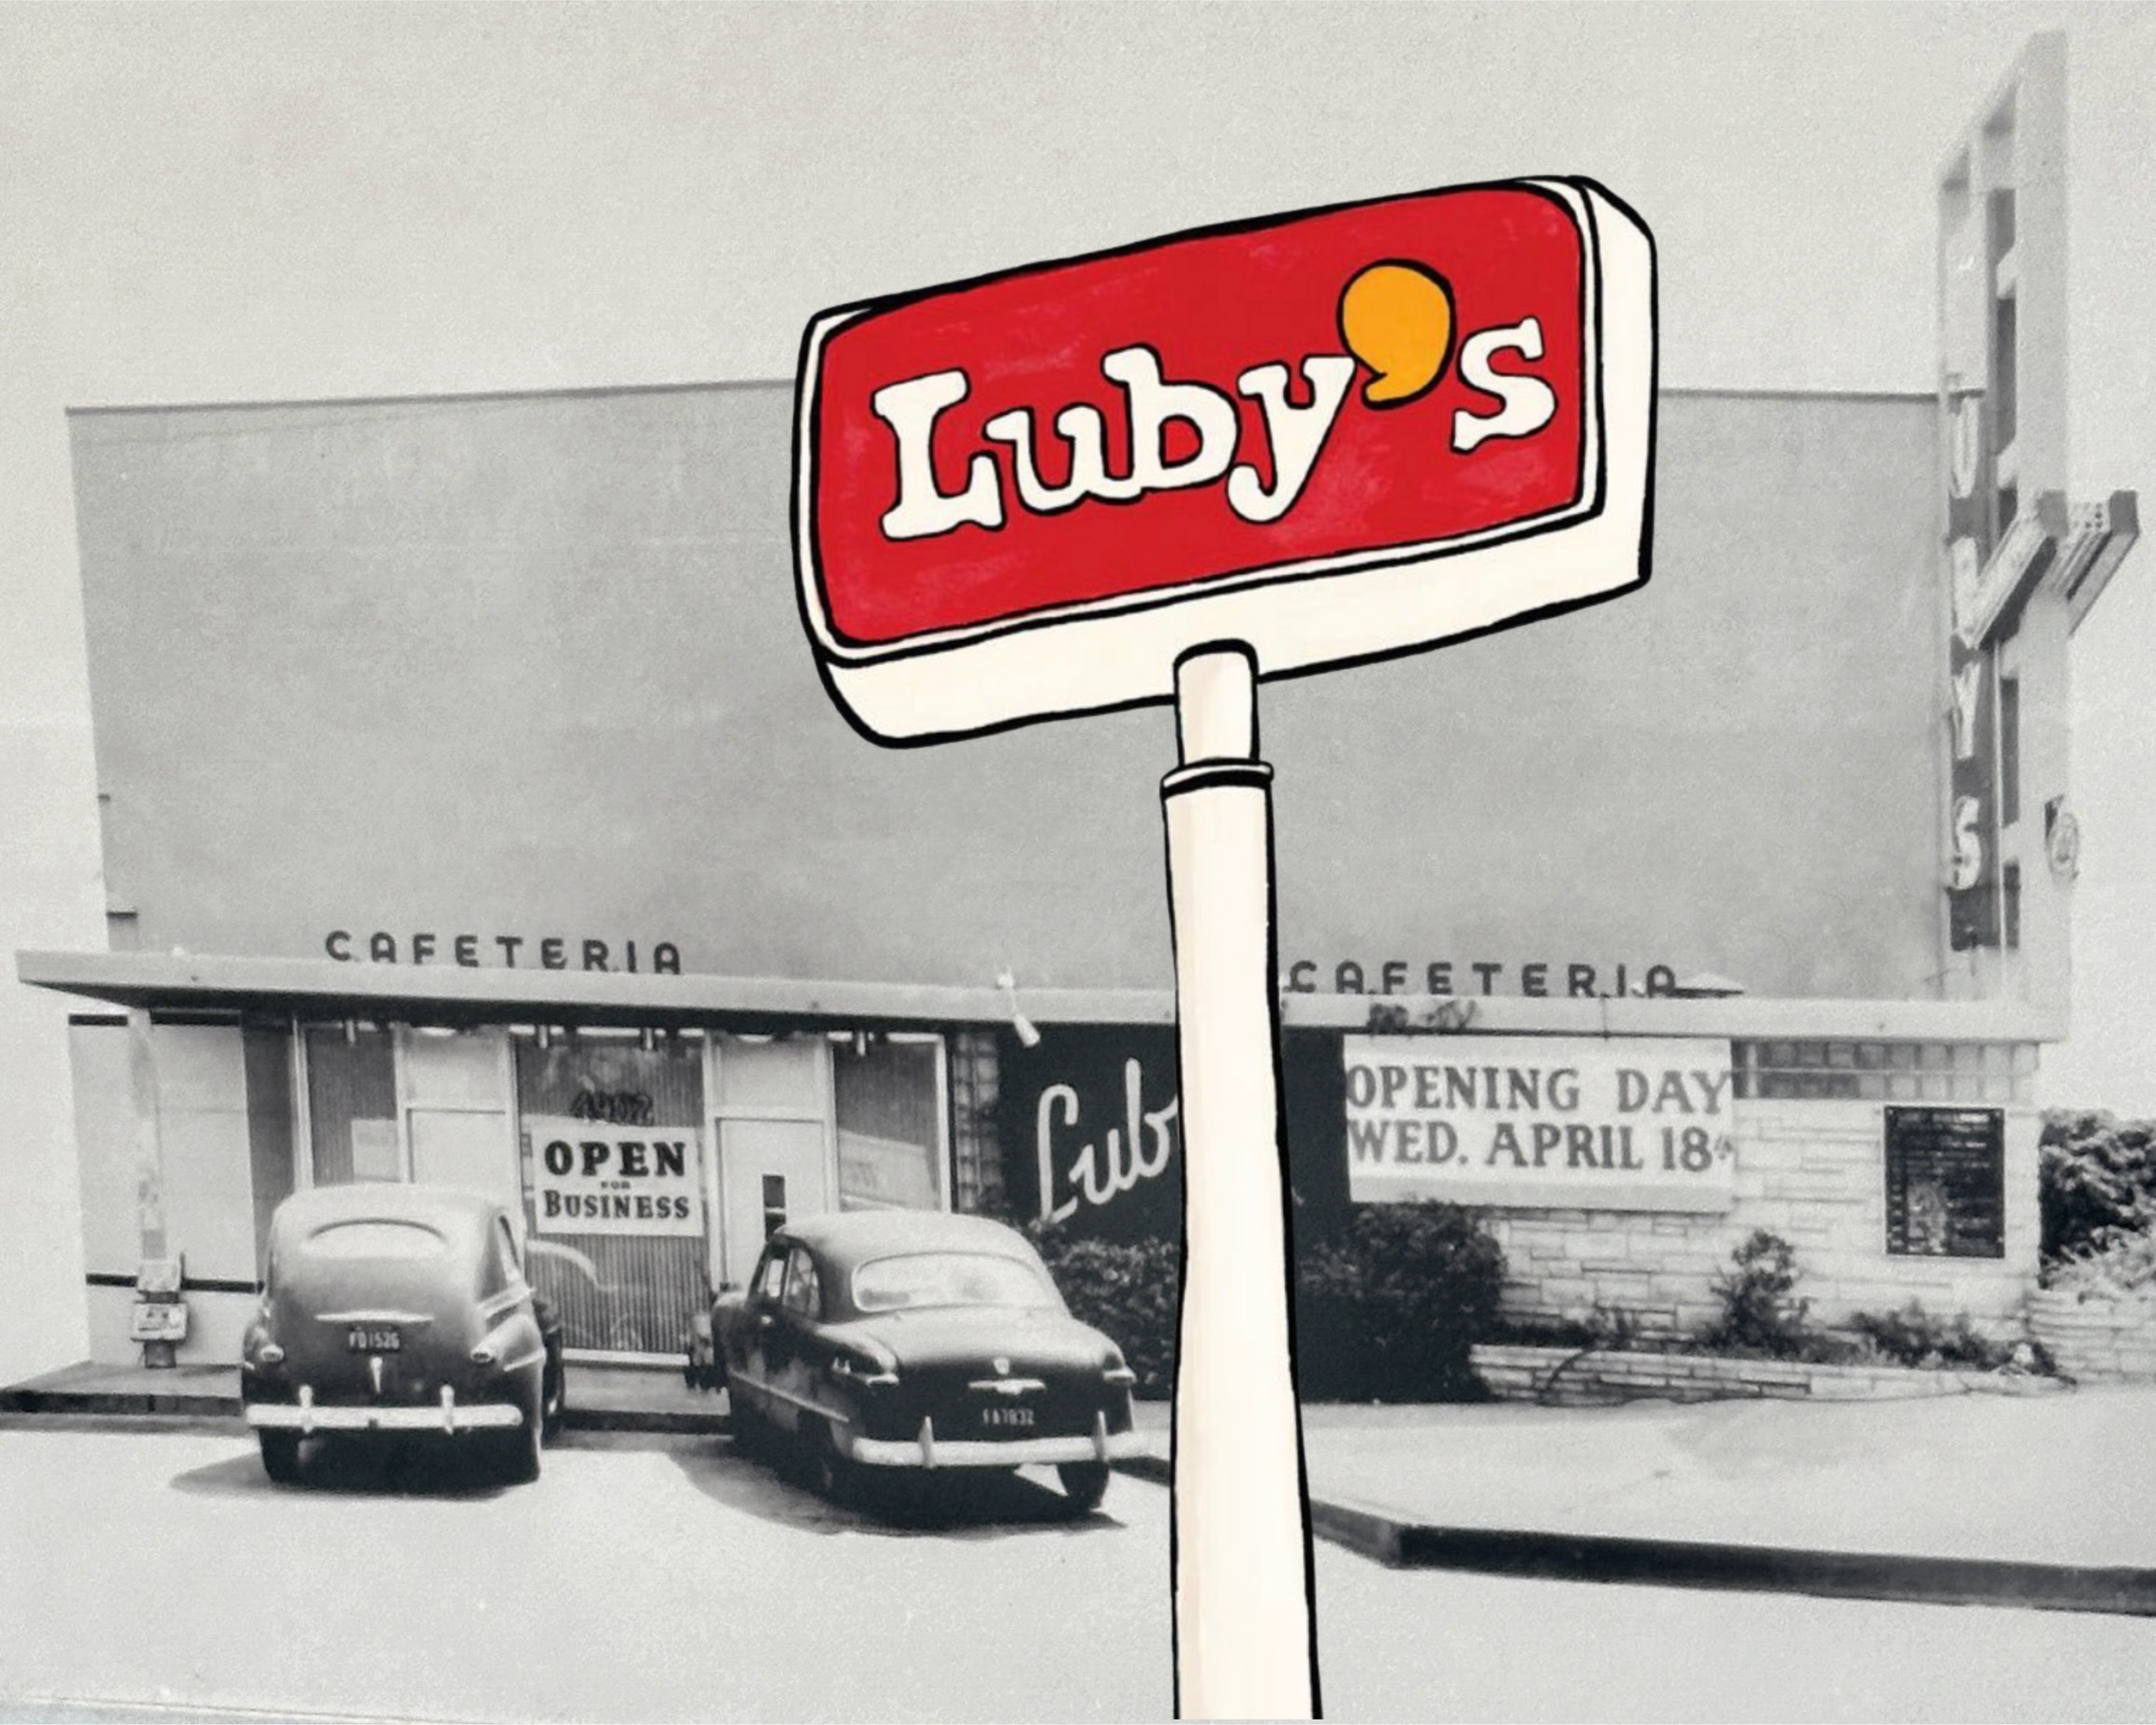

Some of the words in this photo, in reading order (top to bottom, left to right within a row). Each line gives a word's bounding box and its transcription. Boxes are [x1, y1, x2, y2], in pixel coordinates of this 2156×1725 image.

[869, 258, 1557, 542] Luby's
[325, 930, 681, 975] CAFETERIA
[1288, 959, 1677, 998] CAFETERIA
[1345, 1063, 1581, 1112] OPENING
[1615, 1068, 1732, 1115] DAY
[543, 1139, 686, 1177] OPEN
[1347, 1119, 1470, 1164] WED.
[1484, 1122, 1645, 1170] APRIL
[543, 1189, 690, 1220] BUSINESS
